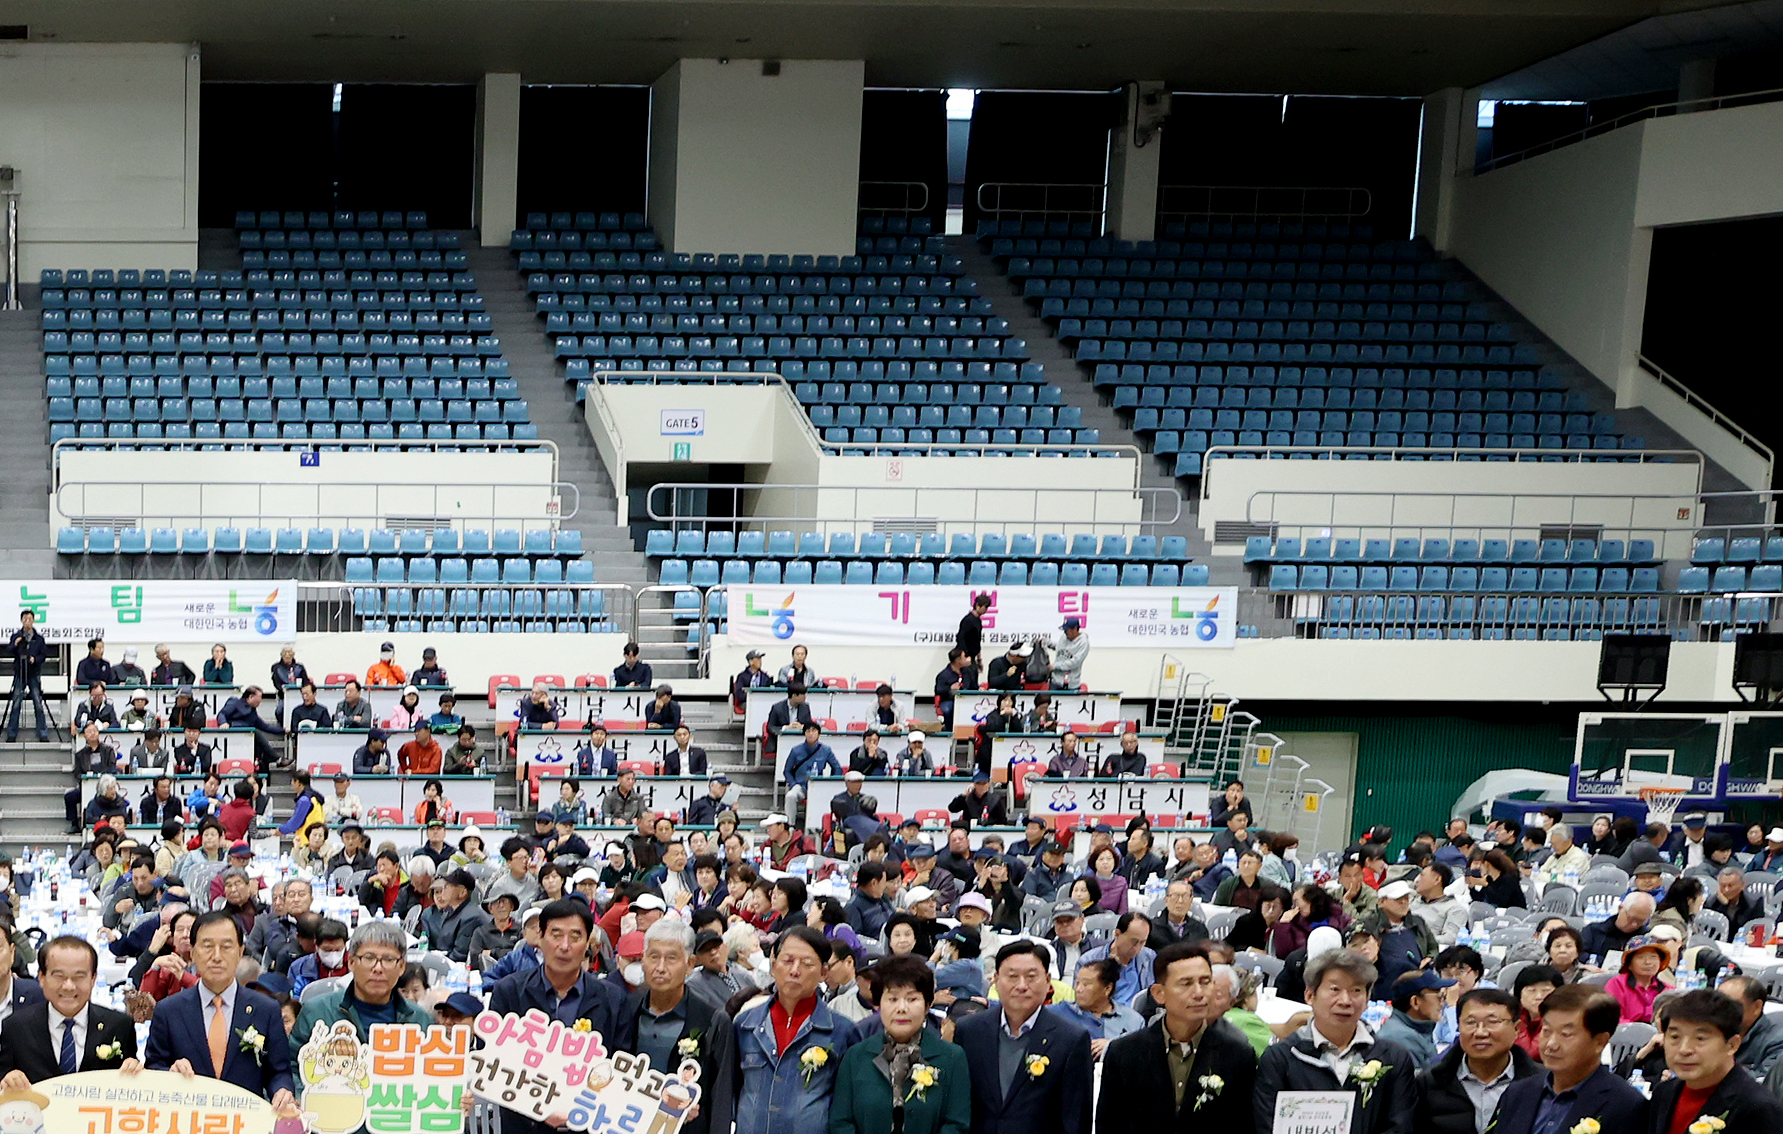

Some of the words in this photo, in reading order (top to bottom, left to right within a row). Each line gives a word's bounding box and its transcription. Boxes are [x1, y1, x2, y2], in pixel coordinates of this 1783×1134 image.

[183, 618, 225, 630] 대한민국
[1127, 624, 1168, 636] 대한민국
[1170, 624, 1190, 636] 농협
[372, 1027, 467, 1077] 밥심
[478, 1012, 604, 1087] 아침밥
[614, 1054, 663, 1100] 먹고
[366, 1083, 463, 1133] 쌀심
[472, 1055, 561, 1116] 건강한
